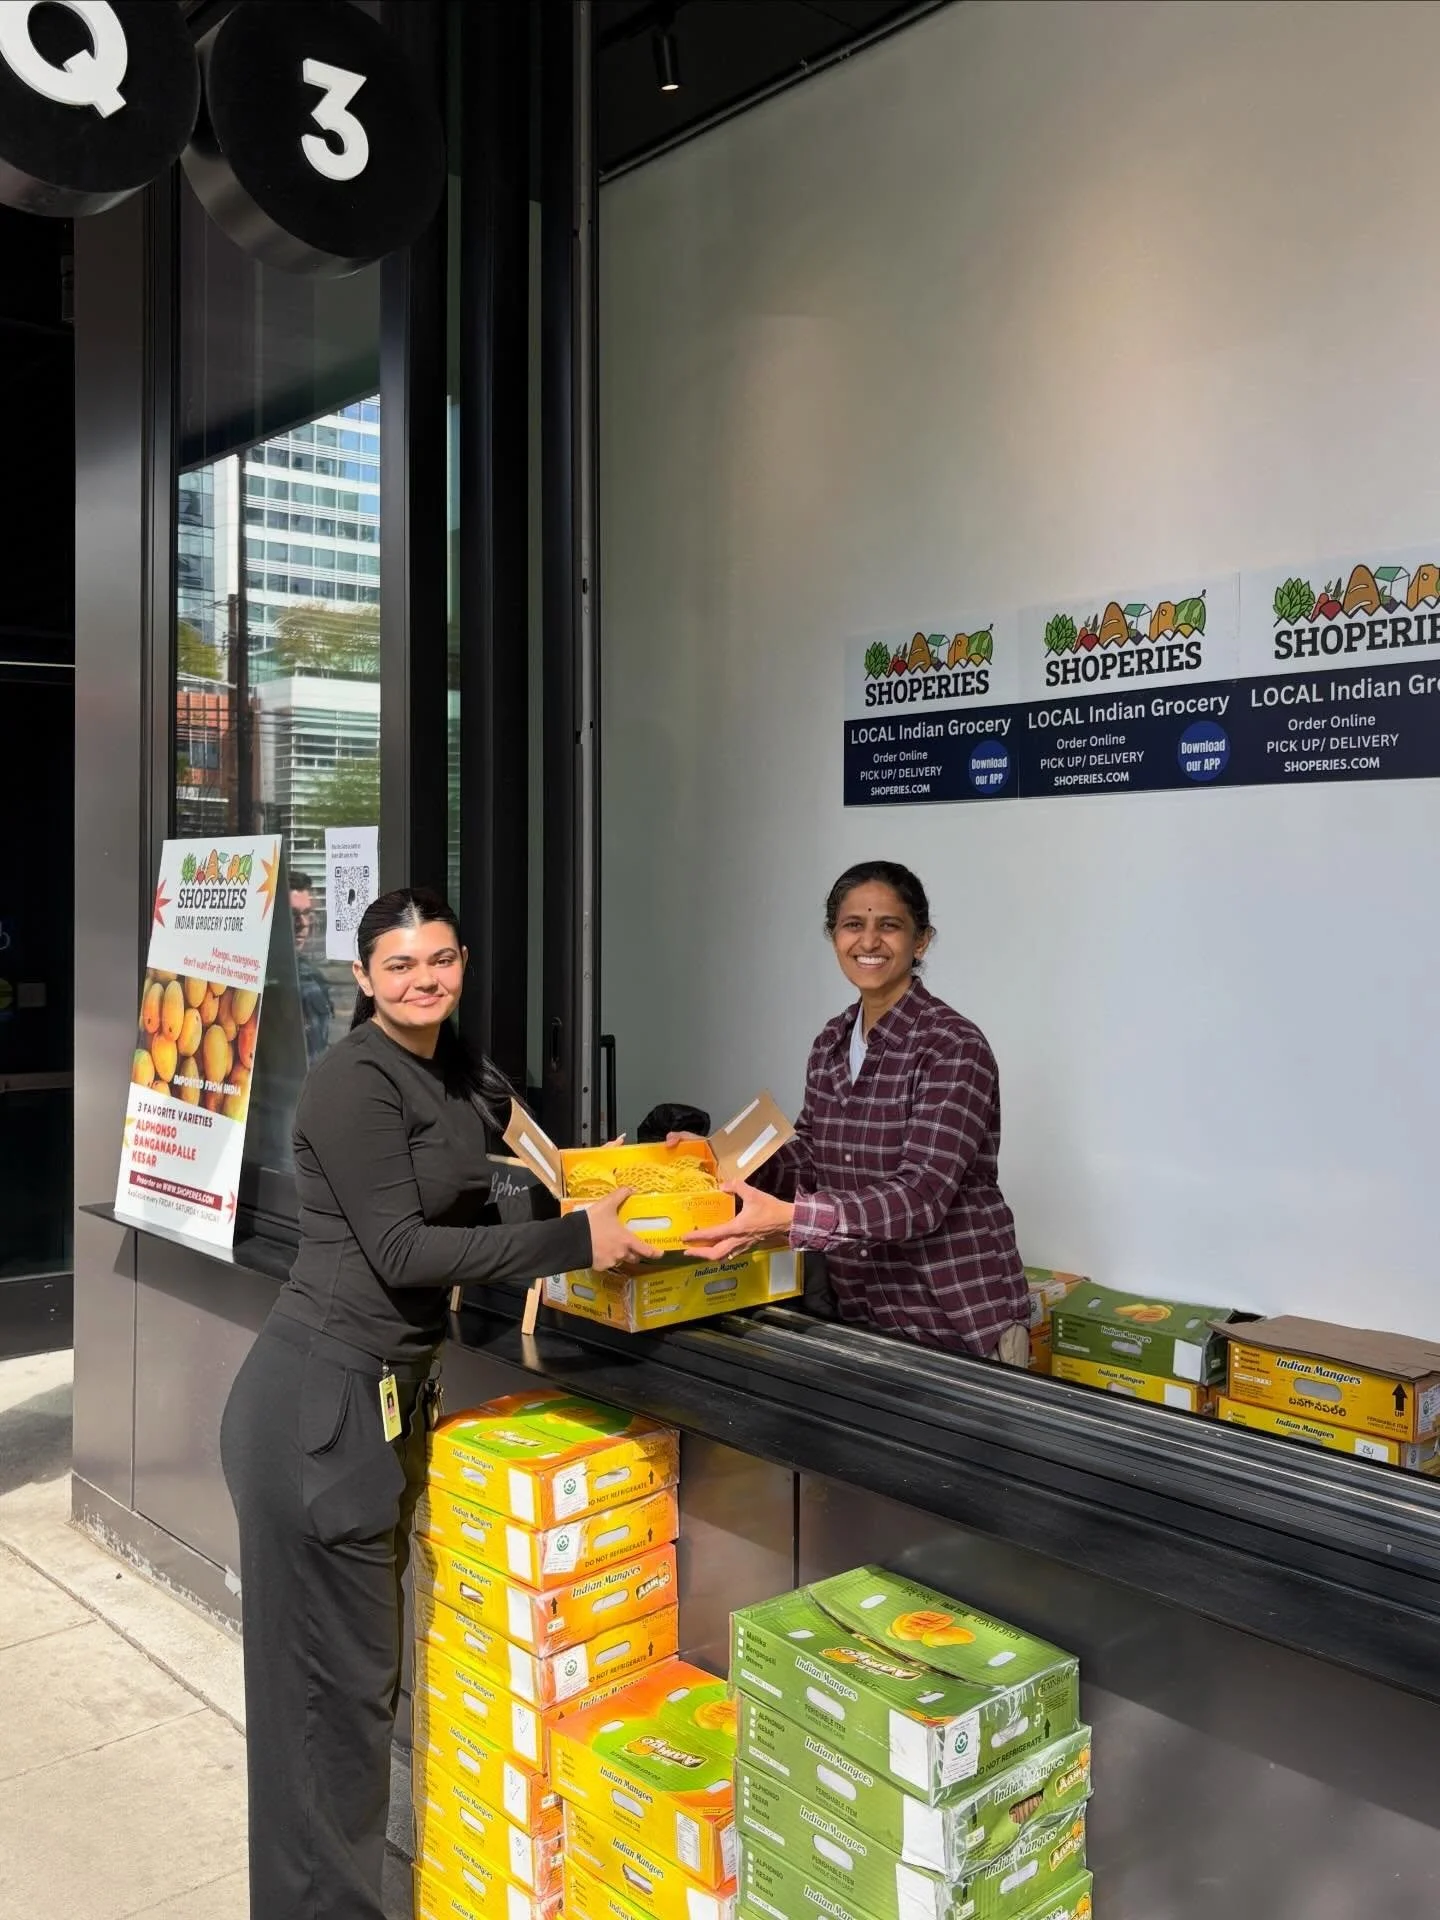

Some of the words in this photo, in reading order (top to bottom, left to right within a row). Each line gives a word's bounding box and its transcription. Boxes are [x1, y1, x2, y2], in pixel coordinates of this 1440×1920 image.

[0, 0, 128, 119] Q
[301, 57, 370, 181] 3
[1045, 641, 1202, 687] SHOPERIES
[865, 669, 990, 707] SHOPERIES
[1251, 684, 1323, 708] LOCAL
[1331, 678, 1401, 701] Indian
[1028, 708, 1084, 729] LOCAL
[1089, 702, 1145, 722] Indian
[1151, 695, 1230, 717] Grocery
[1288, 717, 1327, 731] Order
[1331, 714, 1376, 727] Online
[851, 726, 895, 744] LOCAL
[899, 719, 944, 741] Indian
[948, 717, 1011, 736] Grocery
[1057, 738, 1087, 750] Order
[1090, 735, 1126, 747] Online
[1181, 739, 1225, 754] Download
[1267, 740, 1297, 753] PICK
[1301, 737, 1326, 752] UP/
[1330, 734, 1400, 750] DELIVERY
[873, 752, 897, 764] Order
[900, 750, 928, 761] Online
[972, 757, 1007, 770] Download
[1040, 757, 1064, 770] PICK
[1068, 755, 1087, 768] UP/
[1090, 751, 1144, 766] DELIVERY
[1187, 762, 1201, 772] our
[1204, 758, 1221, 771] APP
[1284, 757, 1381, 773] SHOPERIES.COM
[860, 770, 879, 781] PICK
[881, 769, 897, 780] UP/
[899, 766, 942, 778] DELIVERY
[976, 776, 988, 786] our
[989, 774, 1003, 785] APP
[1054, 772, 1129, 786] SHOPERIES.COM
[871, 784, 930, 796] SHOPERIES.COM
[177, 888, 247, 909] SHOPERIES
[175, 915, 195, 930] INDIAN
[195, 916, 223, 931] GROCERY
[223, 917, 244, 931] STORE
[173, 1075, 204, 1088] IMPORTED
[204, 1080, 223, 1093] FROM
[223, 1083, 241, 1096] INDIA
[137, 1102, 142, 1112] 3
[143, 1103, 175, 1120] FAVORITE
[178, 1110, 214, 1128] VARIETIES
[136, 1119, 177, 1139] ALPHONSO
[131, 1150, 157, 1167] KESAR
[133, 1134, 197, 1161] BANGANAPALLE
[695, 1266, 718, 1278] Indian
[718, 1261, 749, 1273] Mangoes
[1101, 1325, 1122, 1338] Indian
[1123, 1331, 1151, 1344] Mangoes
[1098, 1368, 1119, 1380] Indian
[1119, 1373, 1145, 1386] Mangoes
[1276, 1358, 1311, 1374] Indian
[1313, 1365, 1361, 1385] Mangoes
[1394, 1410, 1404, 1418] UP
[1275, 1417, 1301, 1430] Indian
[1302, 1423, 1335, 1439] Mangoes
[452, 1448, 469, 1461] Indian
[471, 1456, 494, 1470] Mangoes
[596, 1495, 609, 1504] NOT
[610, 1482, 647, 1499] REFRIGERATE
[452, 1505, 468, 1518] Indian
[470, 1513, 492, 1528] Mangoes
[585, 1559, 595, 1568] DO
[596, 1554, 608, 1565] NOT
[609, 1540, 646, 1557] REFRIGERATE
[451, 1560, 468, 1574] Indian
[469, 1569, 491, 1586] Mangoes
[572, 1582, 602, 1598] Indian
[603, 1565, 641, 1585] Mangoes
[595, 1672, 608, 1681] NOT
[610, 1655, 647, 1674] REFRIGERATE
[796, 1656, 822, 1680] Indian
[824, 1672, 857, 1700] Mangoes
[455, 1670, 471, 1686] Indian
[473, 1681, 495, 1700] Mangoes
[805, 1704, 834, 1727] PERISHABLE
[834, 1719, 846, 1734] ITEM
[450, 1727, 467, 1744] Indian
[467, 1740, 488, 1759] Mangoes
[985, 1759, 999, 1771] NOT
[1000, 1735, 1043, 1763] REFRIGERATE
[806, 1737, 833, 1762] Indian
[835, 1755, 873, 1787] Mangoes
[600, 1766, 622, 1786] Indian
[624, 1781, 653, 1803] Mangoes
[452, 1785, 470, 1803] Indian
[471, 1798, 493, 1821] Mangoes
[815, 1786, 845, 1811] PERISHABLE
[845, 1804, 858, 1818] ITEM
[800, 1806, 828, 1831] Indian
[829, 1824, 866, 1856] Mangoes
[453, 1844, 471, 1861] Indian
[471, 1858, 492, 1880] Mangoes
[612, 1837, 634, 1858] Indian
[635, 1854, 663, 1879] Mangoes
[811, 1855, 842, 1878] PERISHABLE
[842, 1872, 854, 1886] ITEM
[451, 1900, 470, 1918] Indian
[609, 1900, 631, 1920] Indian
[804, 1886, 833, 1911] Indian
